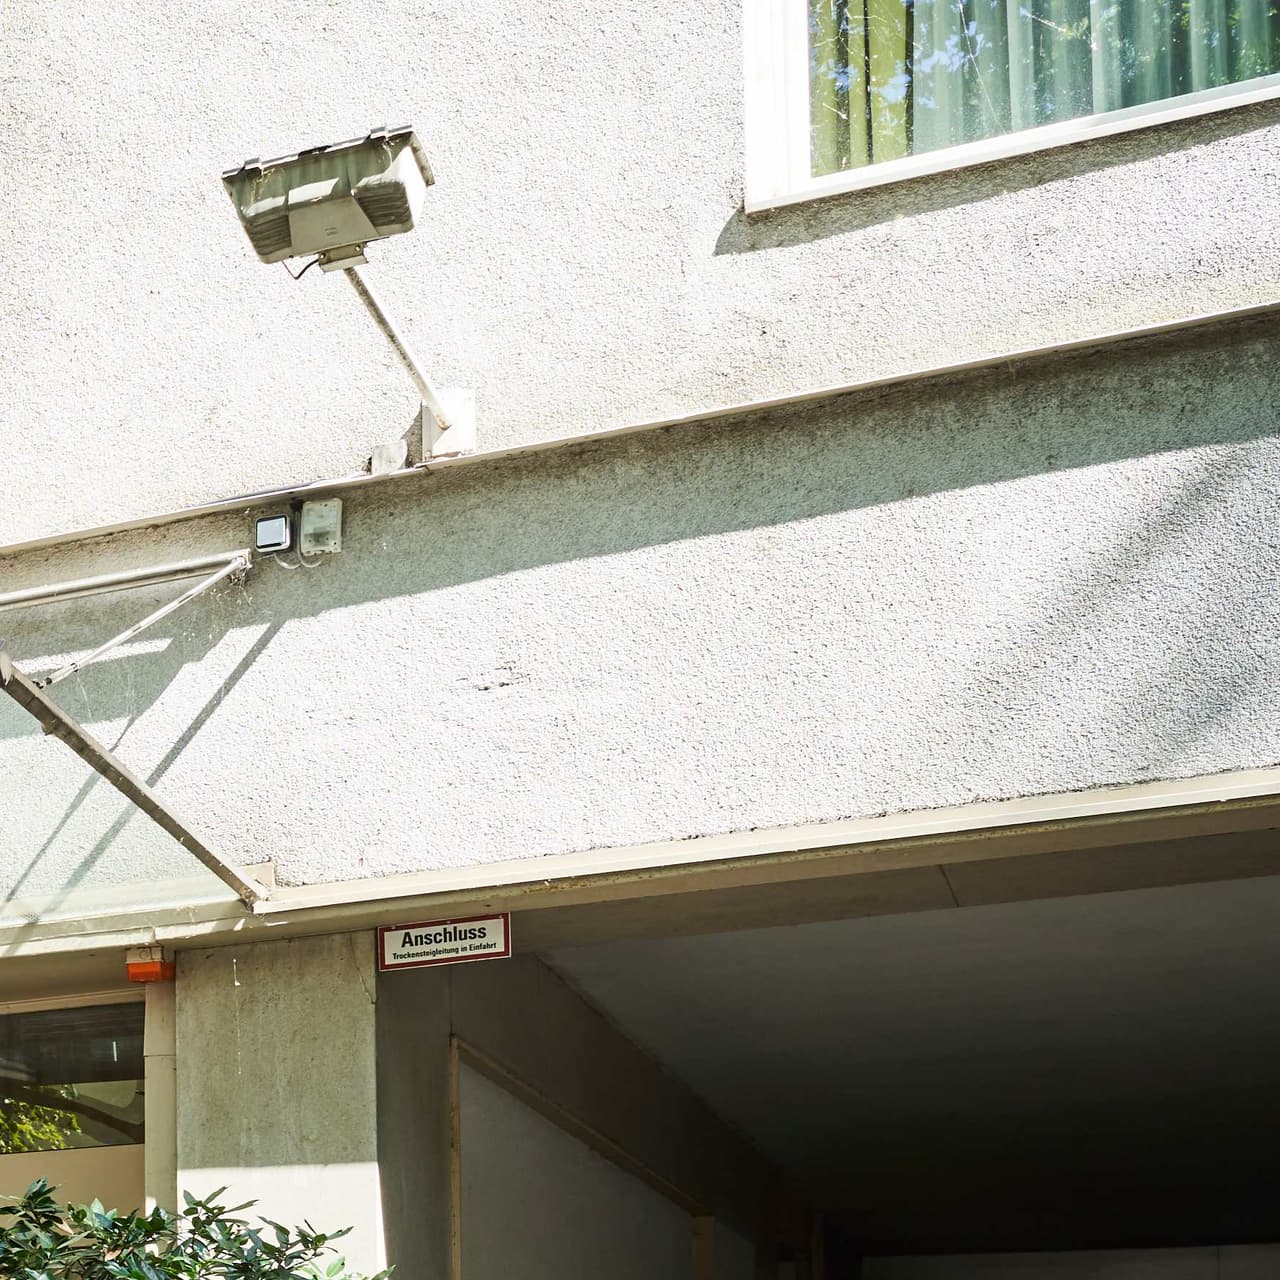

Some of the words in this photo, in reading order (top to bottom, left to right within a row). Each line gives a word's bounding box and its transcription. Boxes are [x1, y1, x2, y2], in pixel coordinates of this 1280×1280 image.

[401, 926, 487, 948] Anschluss
[392, 947, 460, 960] Trockensteigleitung
[469, 942, 497, 952] Einfahrt
